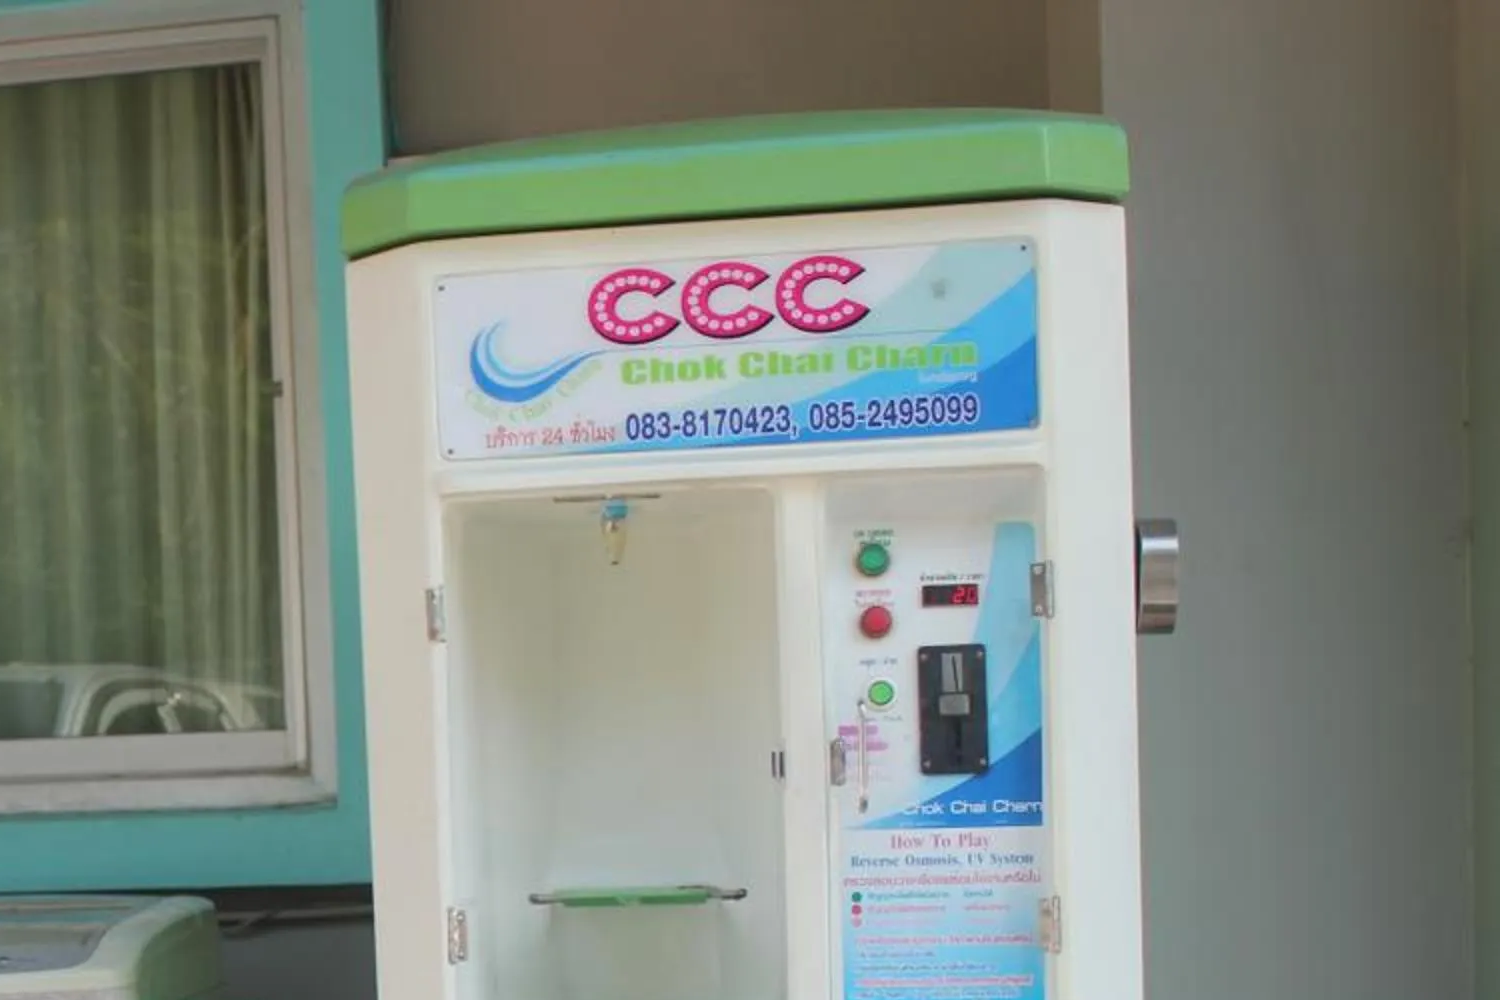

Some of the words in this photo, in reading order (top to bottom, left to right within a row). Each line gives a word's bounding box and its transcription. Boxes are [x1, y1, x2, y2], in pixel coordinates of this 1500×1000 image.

[588, 255, 871, 345] CCC
[620, 354, 728, 386] Chok
[737, 349, 835, 378] Chai
[846, 341, 981, 373] Charn
[485, 425, 535, 449] บริการ
[541, 426, 564, 445] 24
[625, 405, 798, 442] 083-8170423,
[808, 394, 979, 431] 085-2495099
[890, 835, 925, 850] How
[932, 834, 951, 848] To
[958, 832, 991, 849] Play
